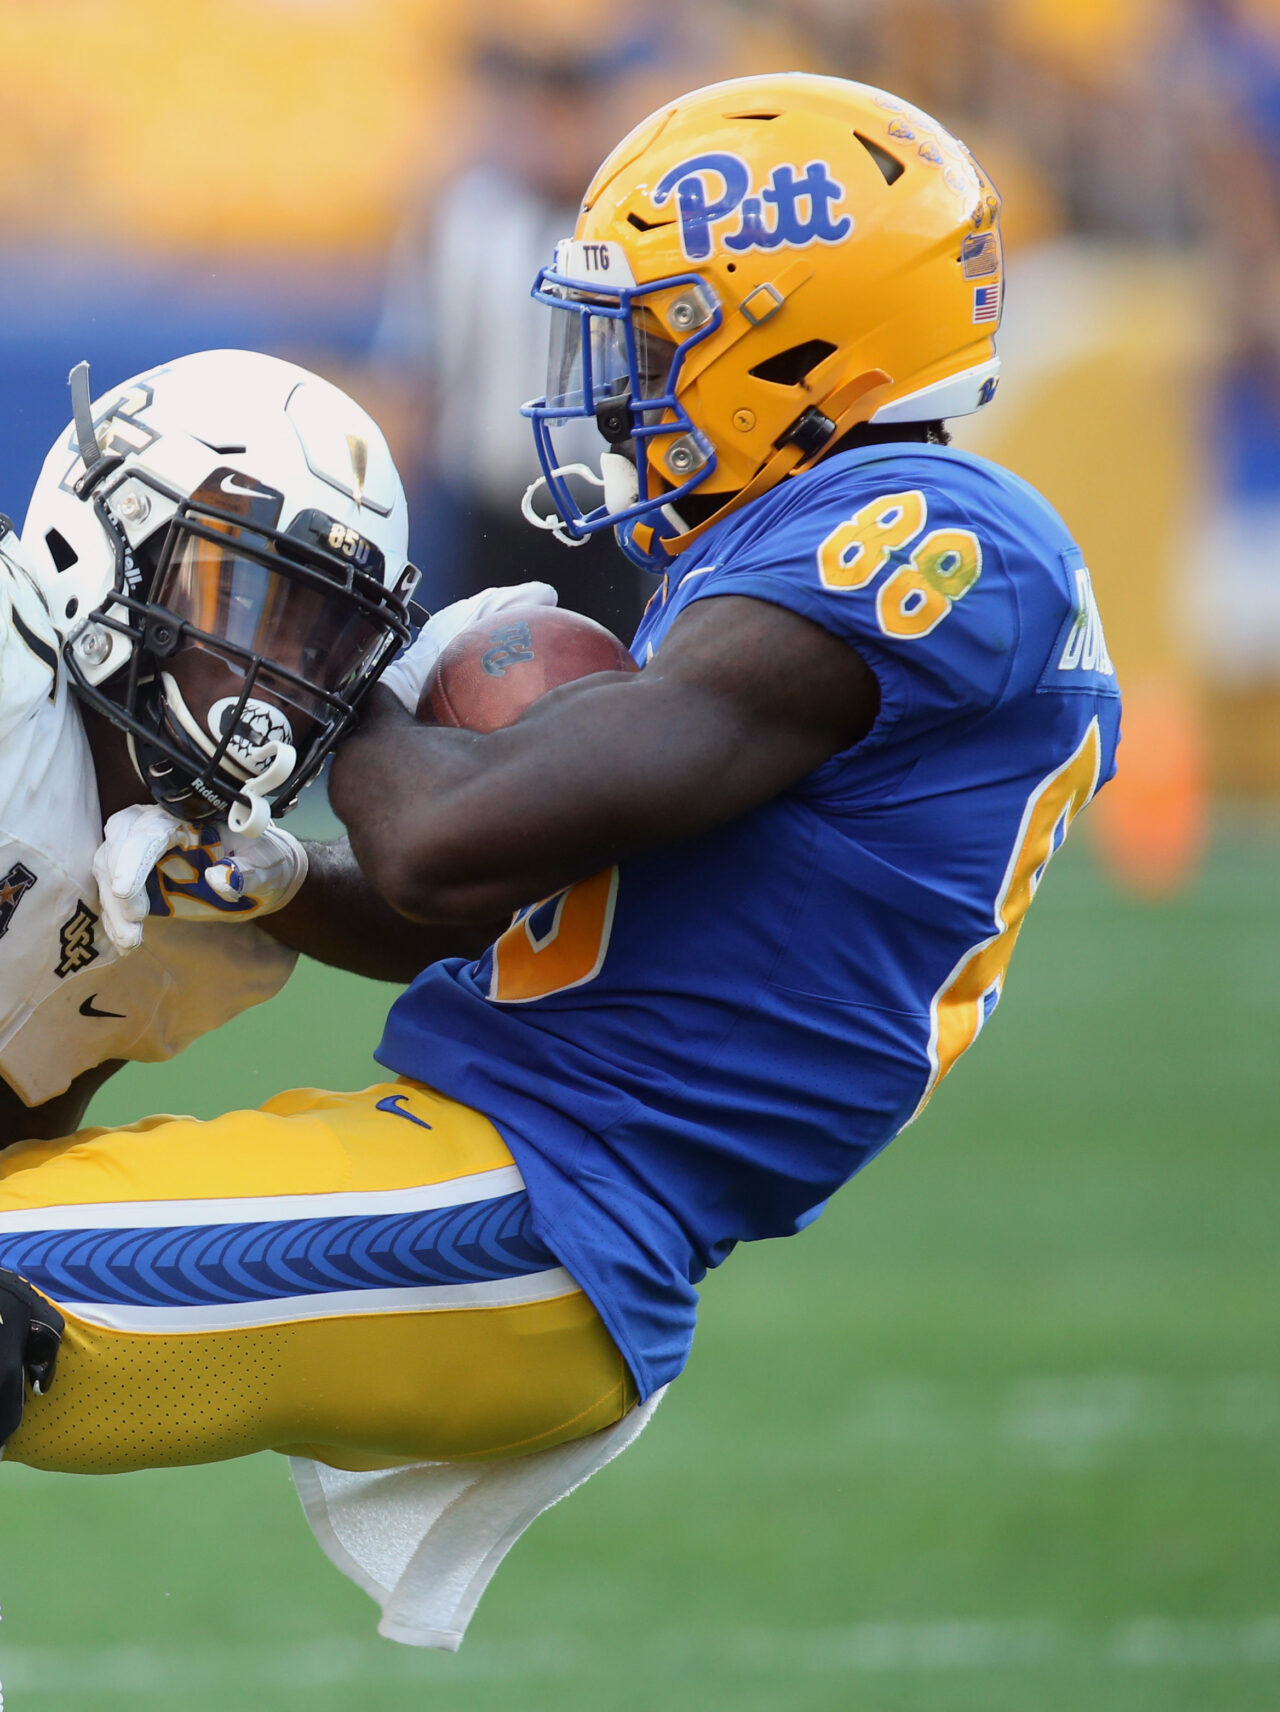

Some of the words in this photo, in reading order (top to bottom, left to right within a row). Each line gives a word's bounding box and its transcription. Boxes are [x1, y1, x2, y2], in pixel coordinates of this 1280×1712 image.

[652, 152, 853, 262] Pitt
[818, 490, 984, 640] 88
[191, 777, 229, 810] Riddell
[54, 898, 100, 978] UCF
